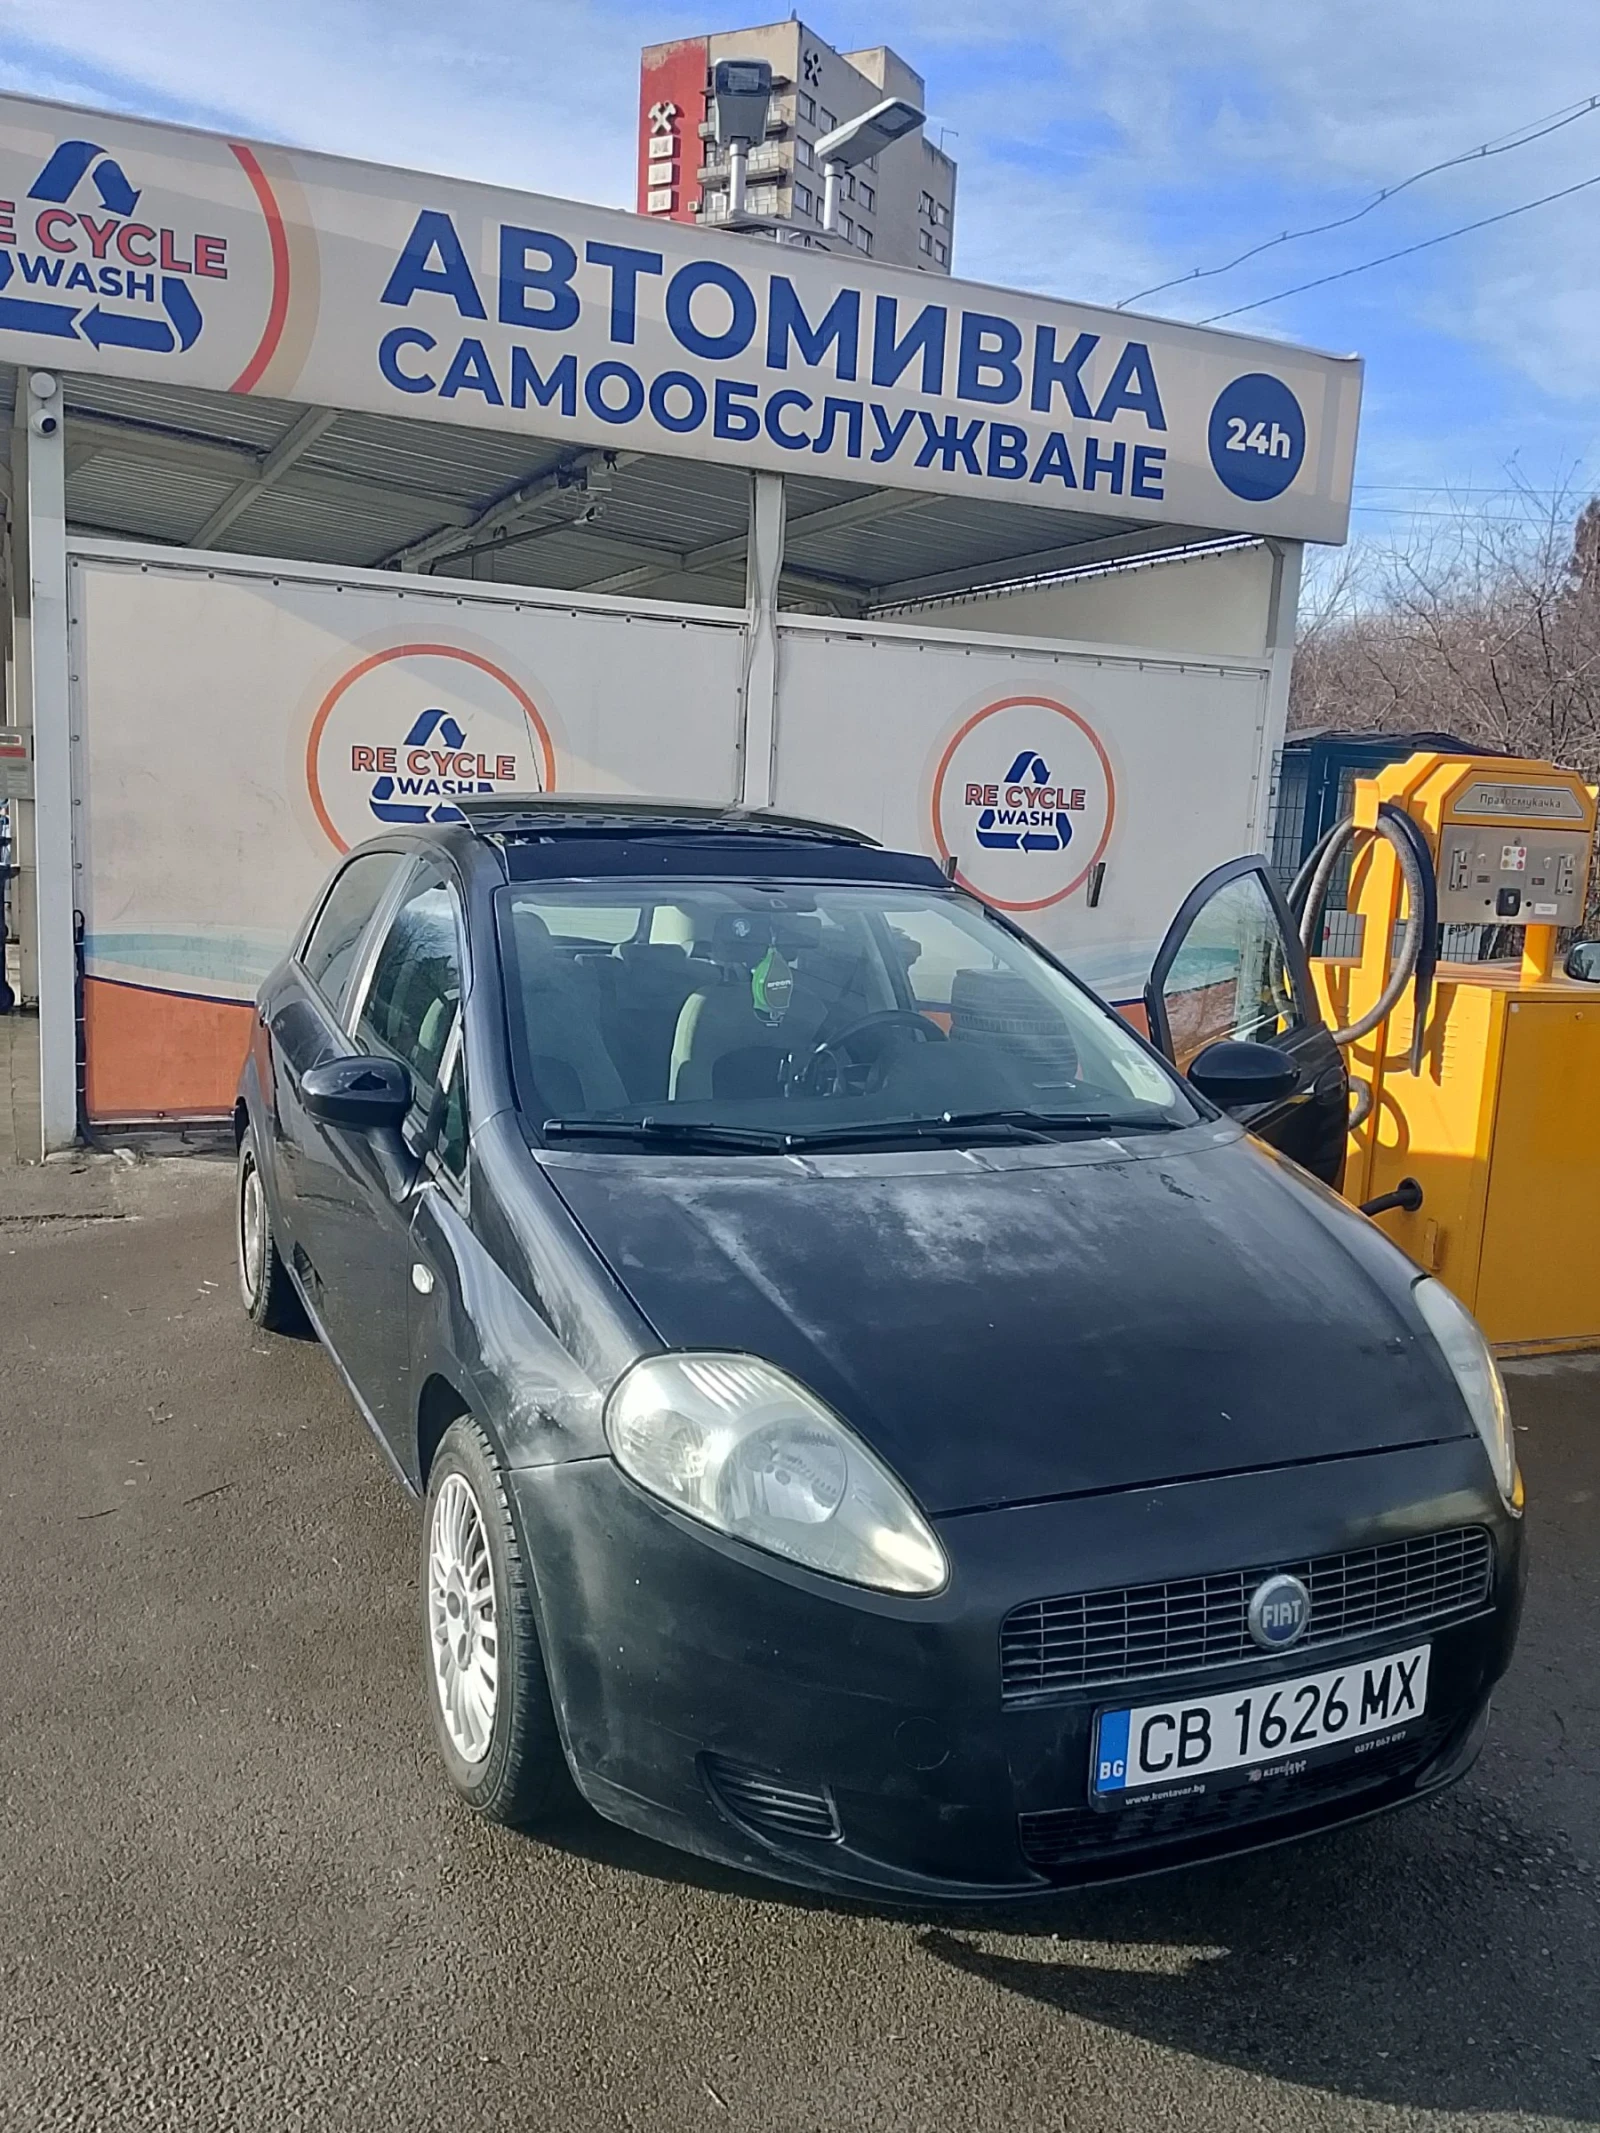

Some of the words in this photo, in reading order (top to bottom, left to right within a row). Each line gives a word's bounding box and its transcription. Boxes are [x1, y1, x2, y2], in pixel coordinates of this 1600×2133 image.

[0, 200, 17, 246] E
[36, 208, 228, 279] CYCLE
[17, 252, 155, 302] WASH
[380, 209, 1168, 432] АВТОМИВКА
[378, 326, 1167, 500] САМООБСЛУЖВАНЕ
[1225, 416, 1291, 459] 24h
[352, 746, 397, 773] RE
[406, 749, 516, 781] CYCLE
[397, 777, 474, 796] WASH
[965, 784, 998, 806] RE
[1005, 785, 1086, 810] CYCLE
[1480, 793, 1561, 809] Прахосмукачка
[997, 810, 1053, 826] WASH
[1262, 1600, 1302, 1629] FIAT
[1138, 1707, 1212, 1773] CB
[1234, 1676, 1349, 1756] 1626
[1359, 1655, 1421, 1726] MX
[1100, 1759, 1124, 1780] BG
